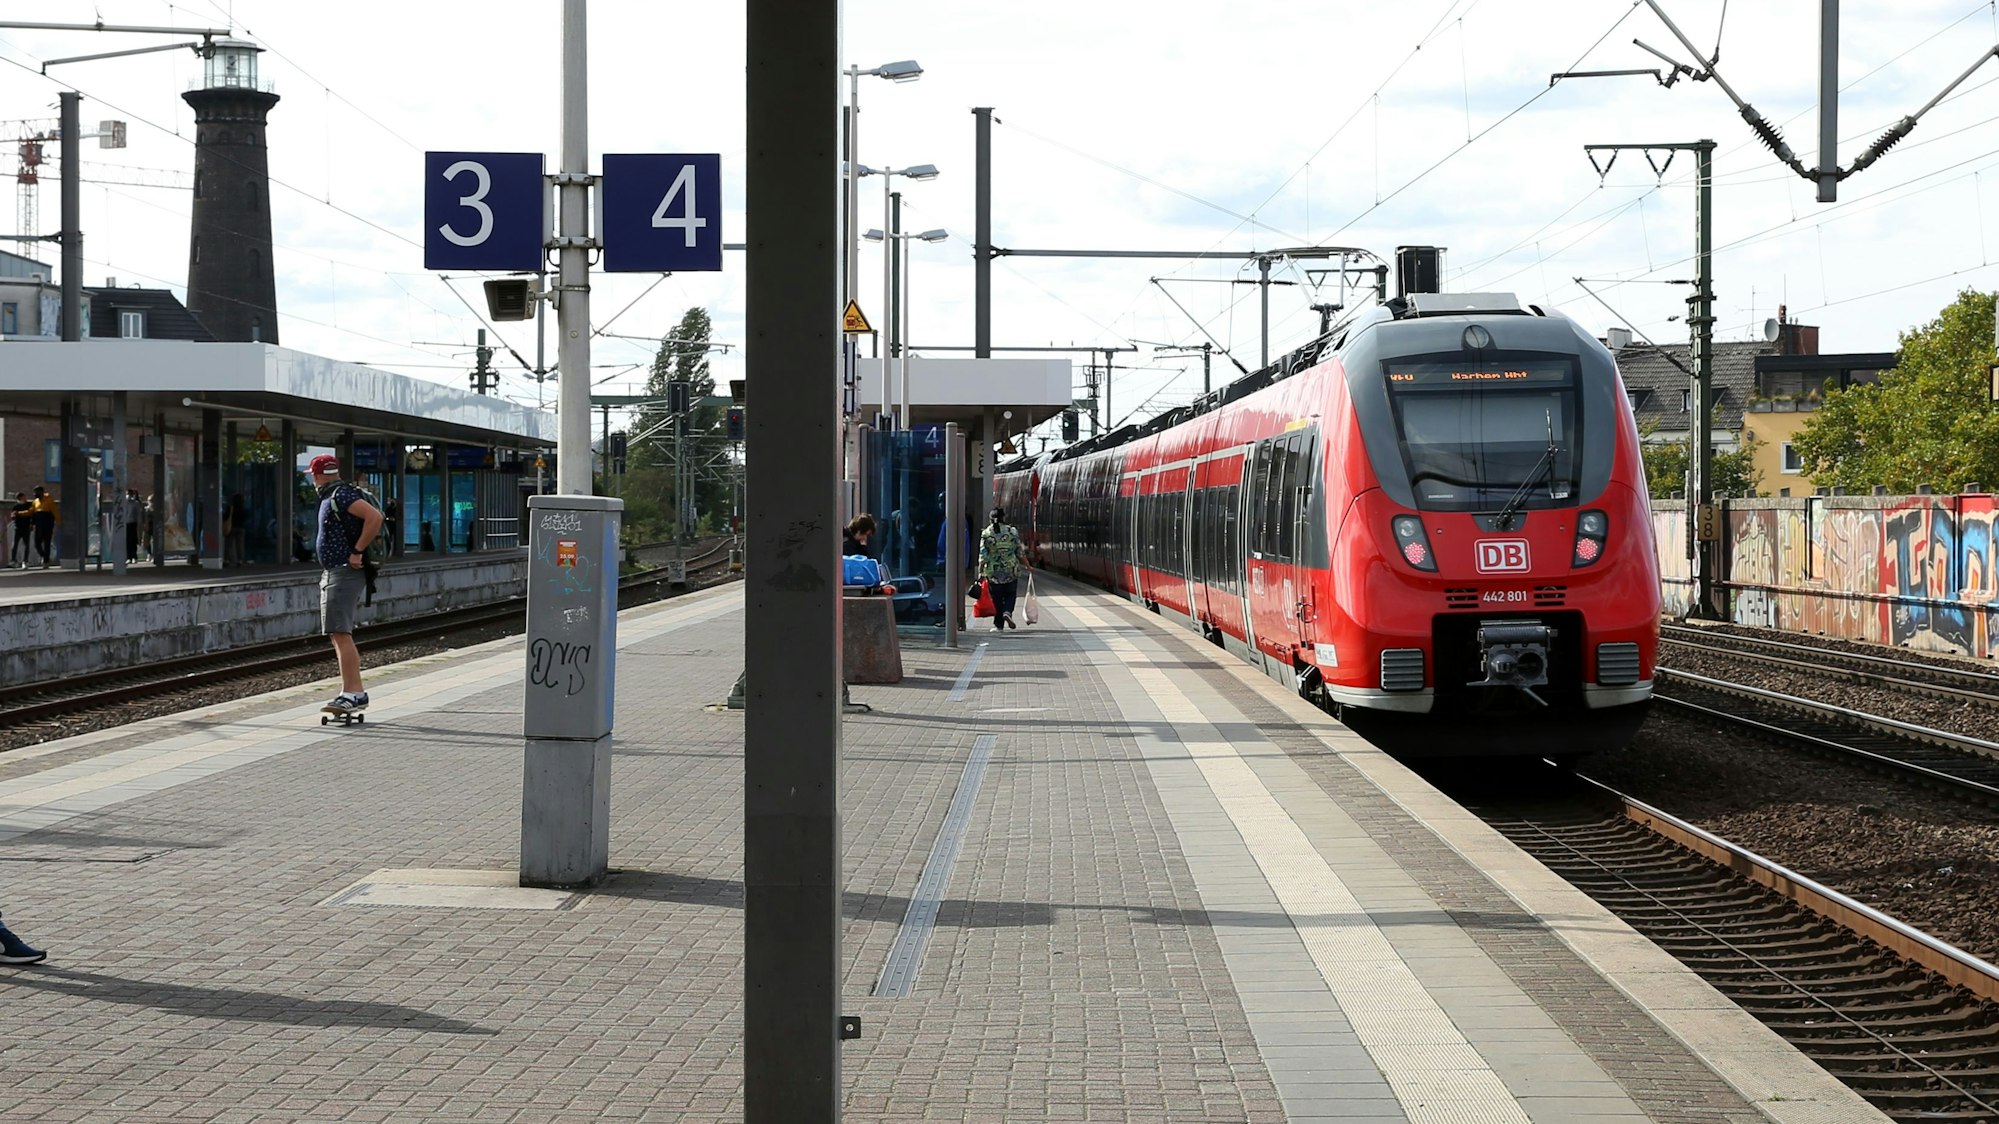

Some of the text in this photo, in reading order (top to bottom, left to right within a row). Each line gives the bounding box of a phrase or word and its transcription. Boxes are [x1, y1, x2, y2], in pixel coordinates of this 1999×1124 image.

[439, 160, 494, 247] 3
[651, 164, 707, 248] 4
[924, 426, 939, 448] 4
[1704, 505, 1713, 521] 3
[1703, 522, 1713, 538] 8
[1482, 544, 1524, 567] DB
[1482, 590, 1527, 602] 442 801
